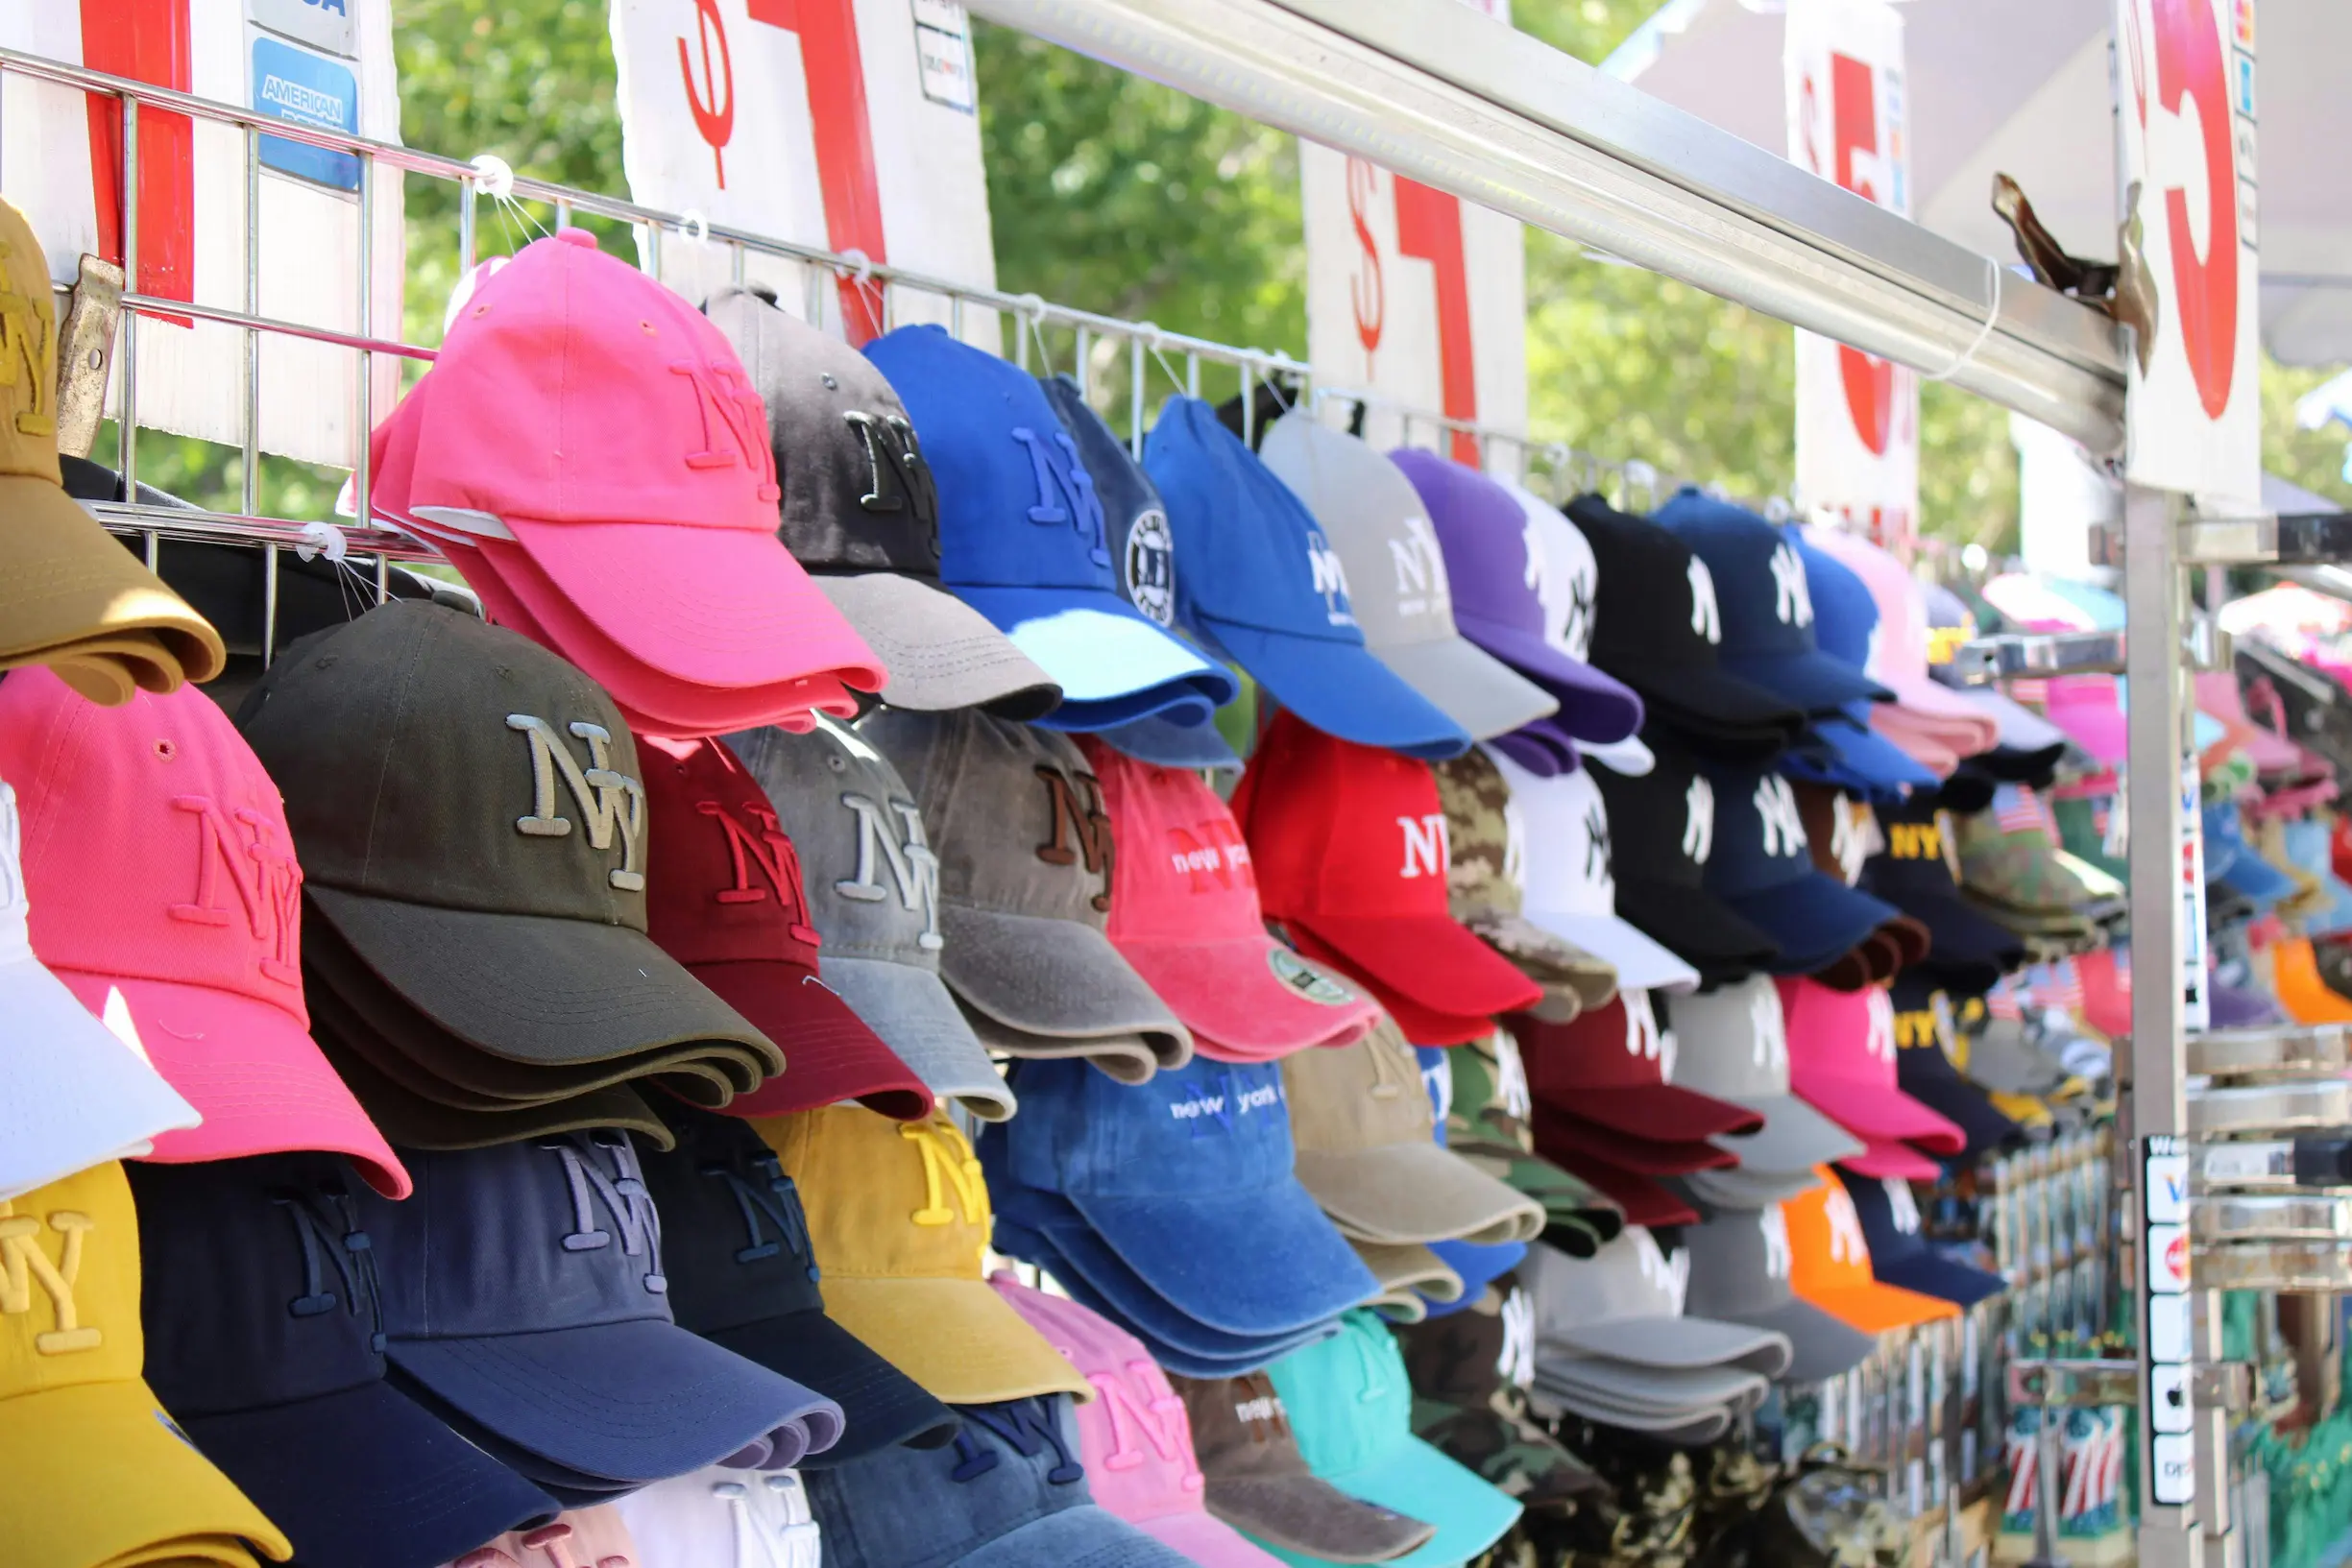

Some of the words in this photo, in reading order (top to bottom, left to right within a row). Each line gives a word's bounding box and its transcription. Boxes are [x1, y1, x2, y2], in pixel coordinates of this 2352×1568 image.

[262, 75, 344, 123] AMERICAN
[506, 713, 644, 891] NY
[695, 802, 821, 947] NY
[836, 793, 944, 949] NY
[1170, 1097, 1224, 1120] new
[540, 1131, 669, 1293] NY
[1085, 1362, 1204, 1491] NY
